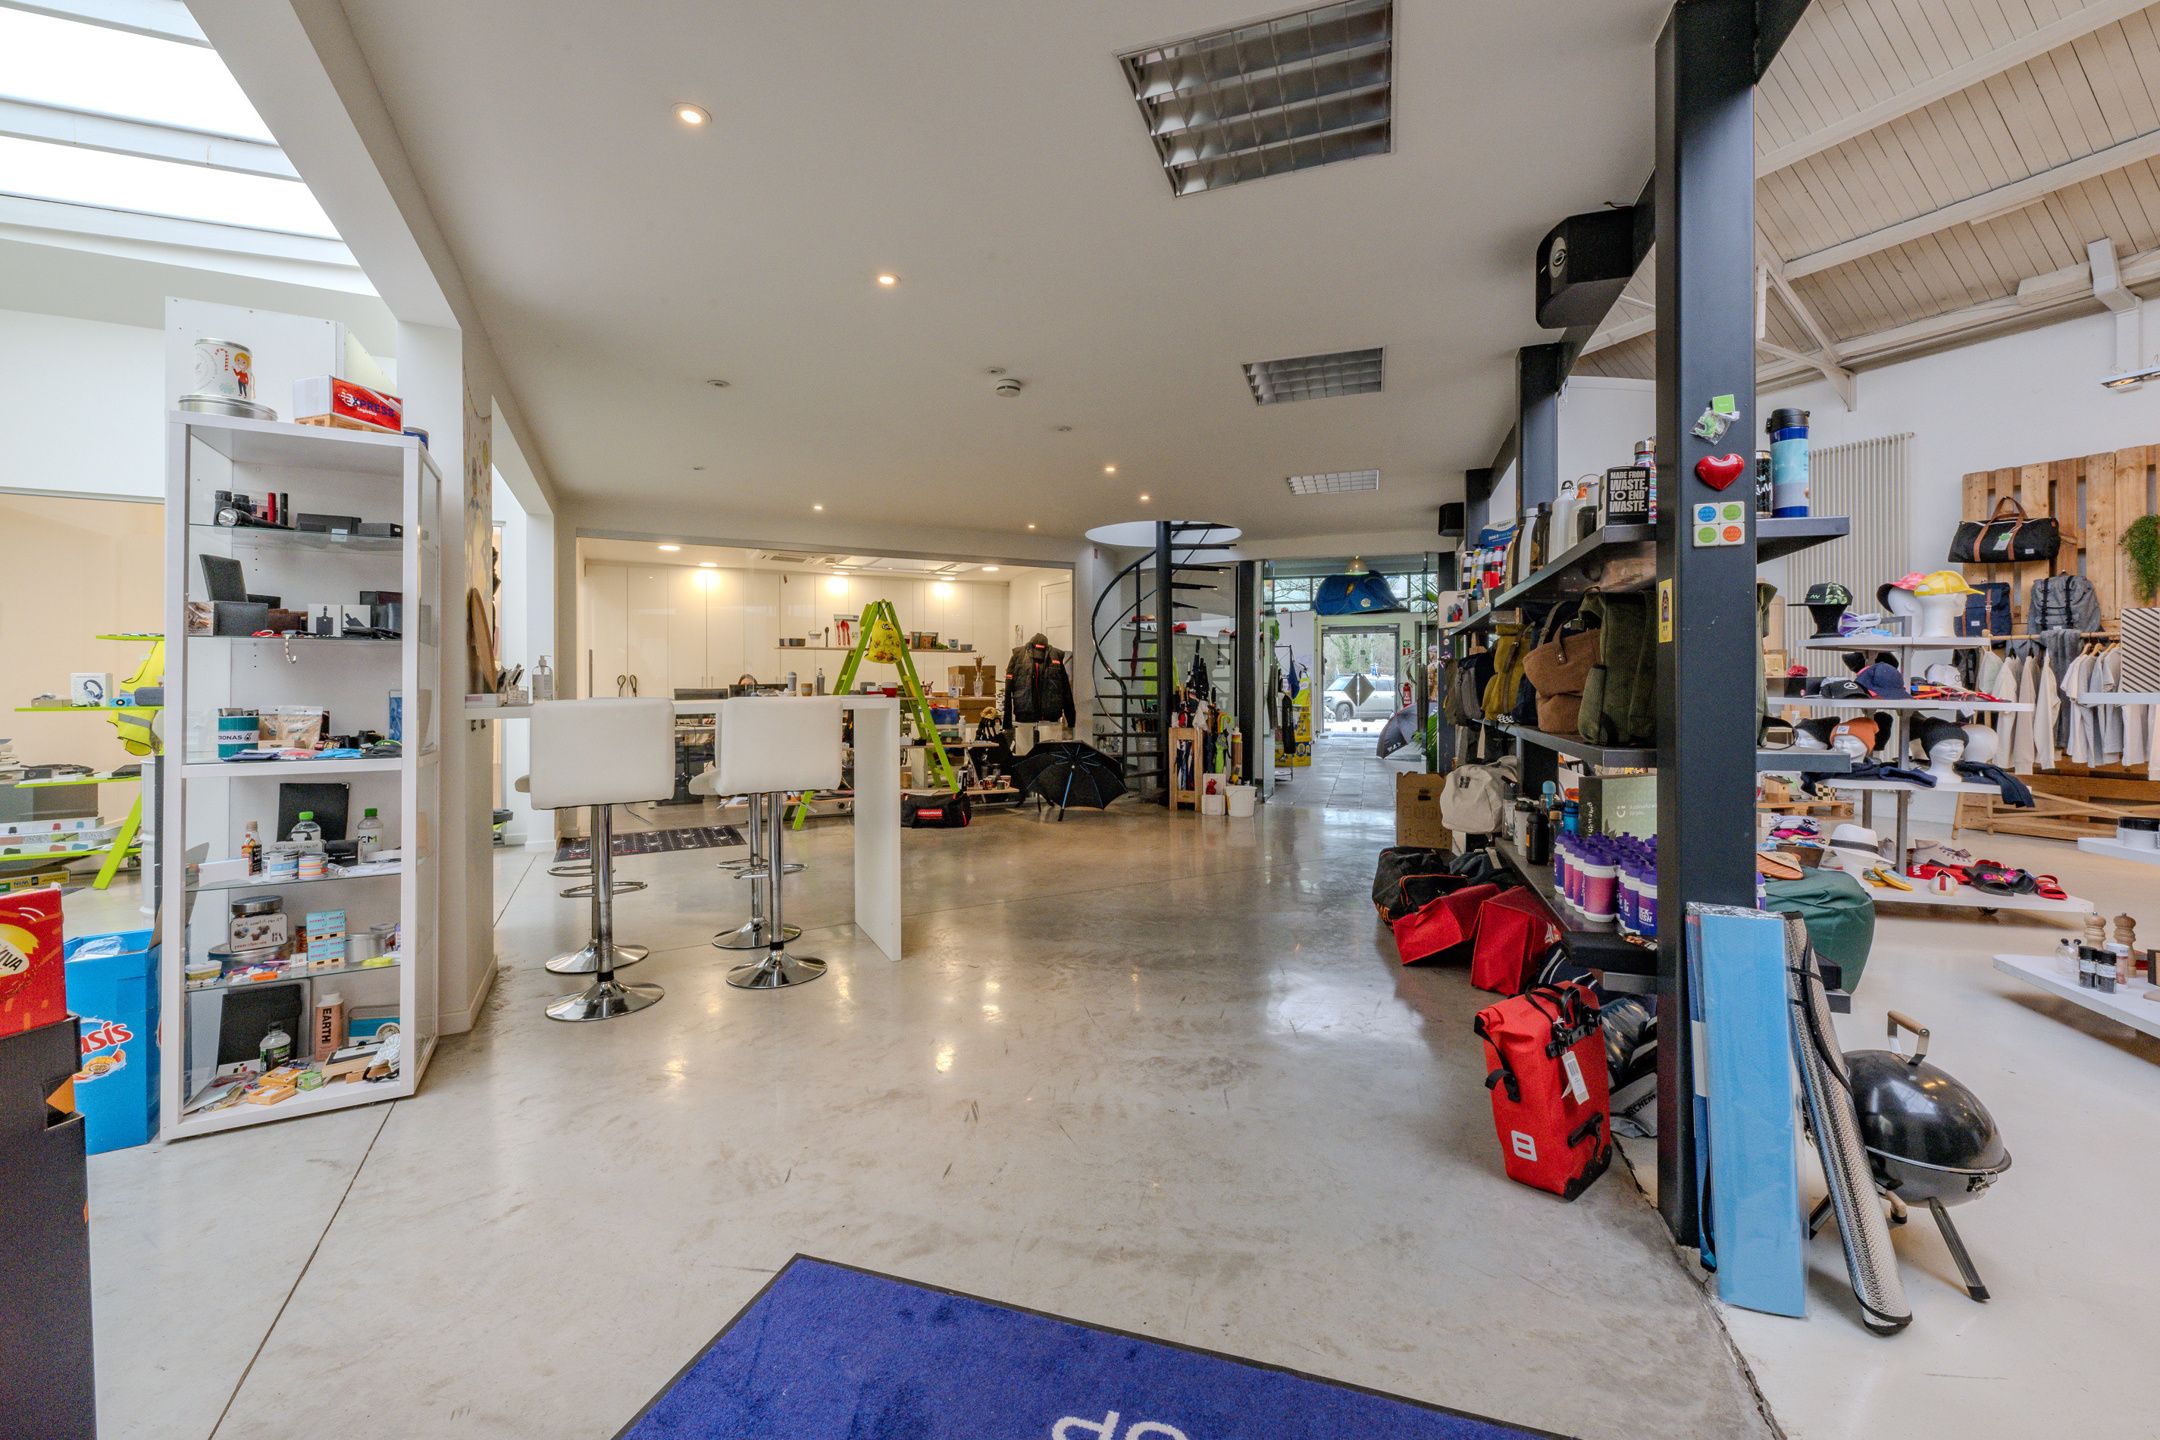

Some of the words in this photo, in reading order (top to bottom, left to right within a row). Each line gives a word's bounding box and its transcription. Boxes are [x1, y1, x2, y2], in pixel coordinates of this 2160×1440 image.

[1611, 471, 1628, 479] MADE
[1629, 470, 1646, 478] FROM
[1611, 479, 1649, 491] WASTE,
[1610, 491, 1627, 500] TO
[1629, 490, 1645, 500] END
[1610, 501, 1648, 512] WASTE.
[321, 1007, 332, 1045] EARTH
